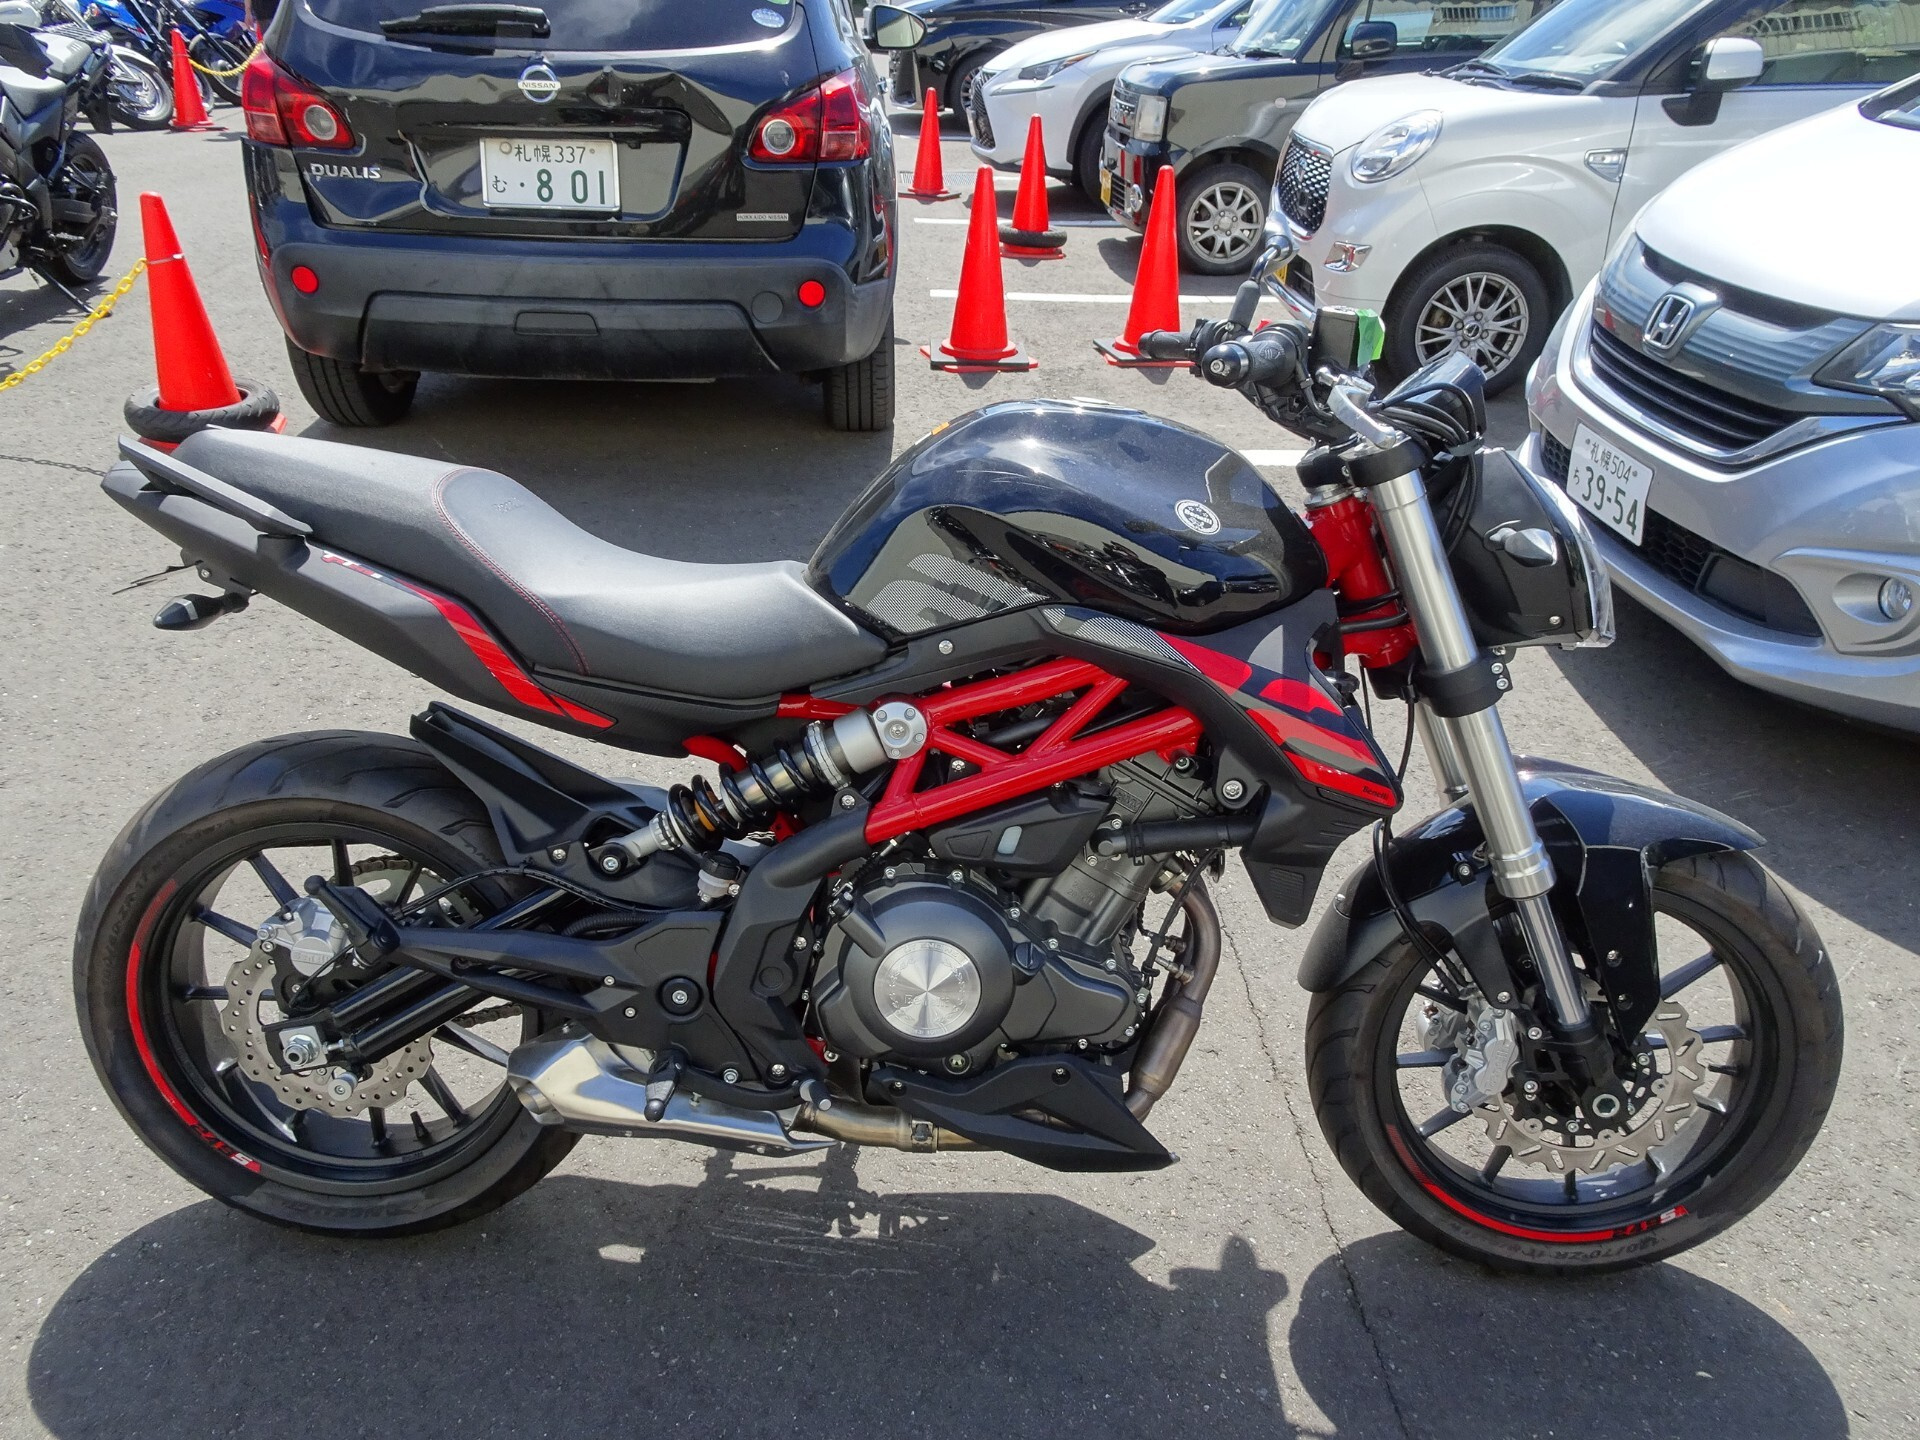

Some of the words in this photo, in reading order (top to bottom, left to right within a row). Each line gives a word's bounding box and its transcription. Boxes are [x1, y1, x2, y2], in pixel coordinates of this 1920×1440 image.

[310, 163, 382, 179] DUALIS
[1582, 466, 1638, 536] 39-54
[1362, 785, 1388, 799] Benelli
